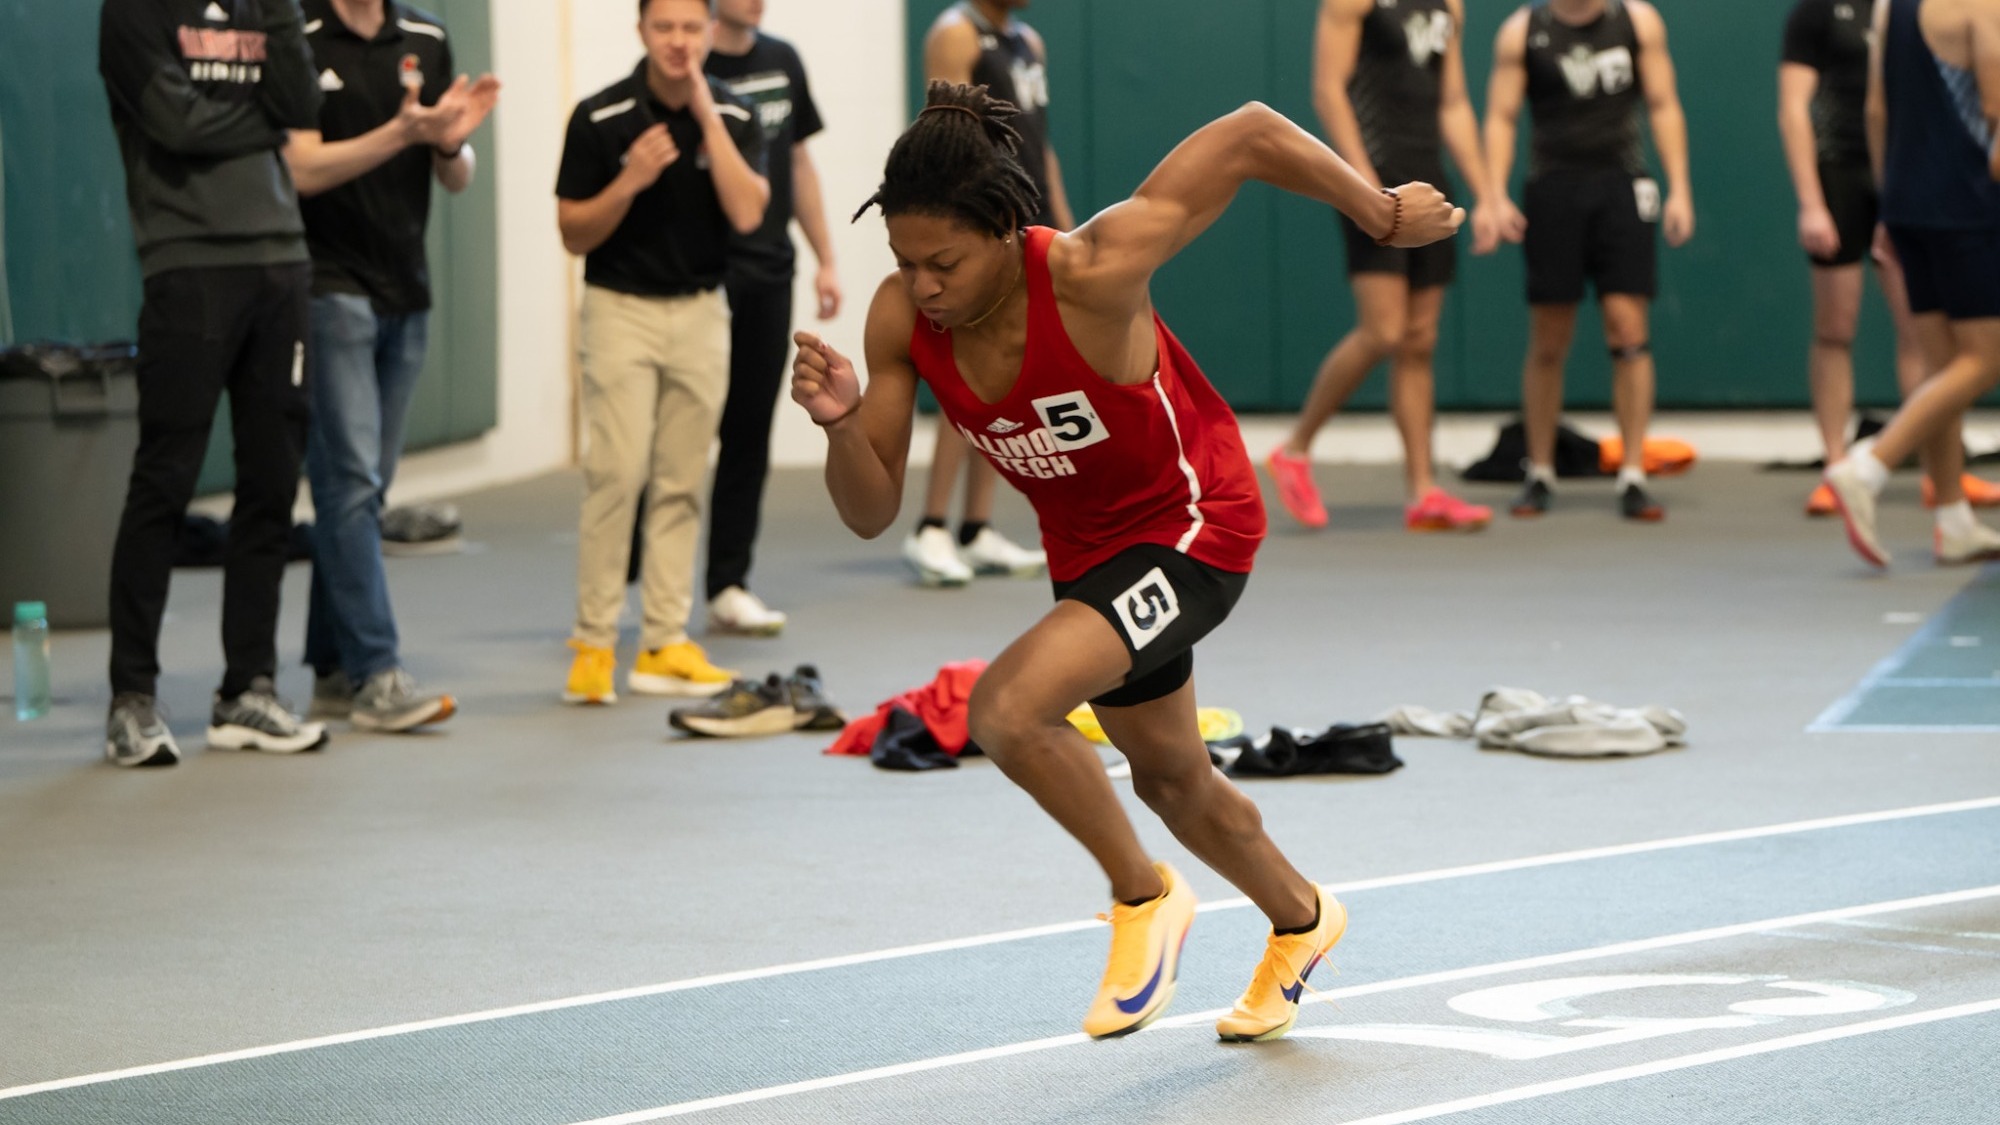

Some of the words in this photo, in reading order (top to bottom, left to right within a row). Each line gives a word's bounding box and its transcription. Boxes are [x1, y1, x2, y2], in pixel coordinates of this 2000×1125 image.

[957, 421, 1057, 458] ILLINO
[1045, 401, 1092, 442] 5
[990, 455, 1078, 479] TECH
[1128, 582, 1171, 631] 5
